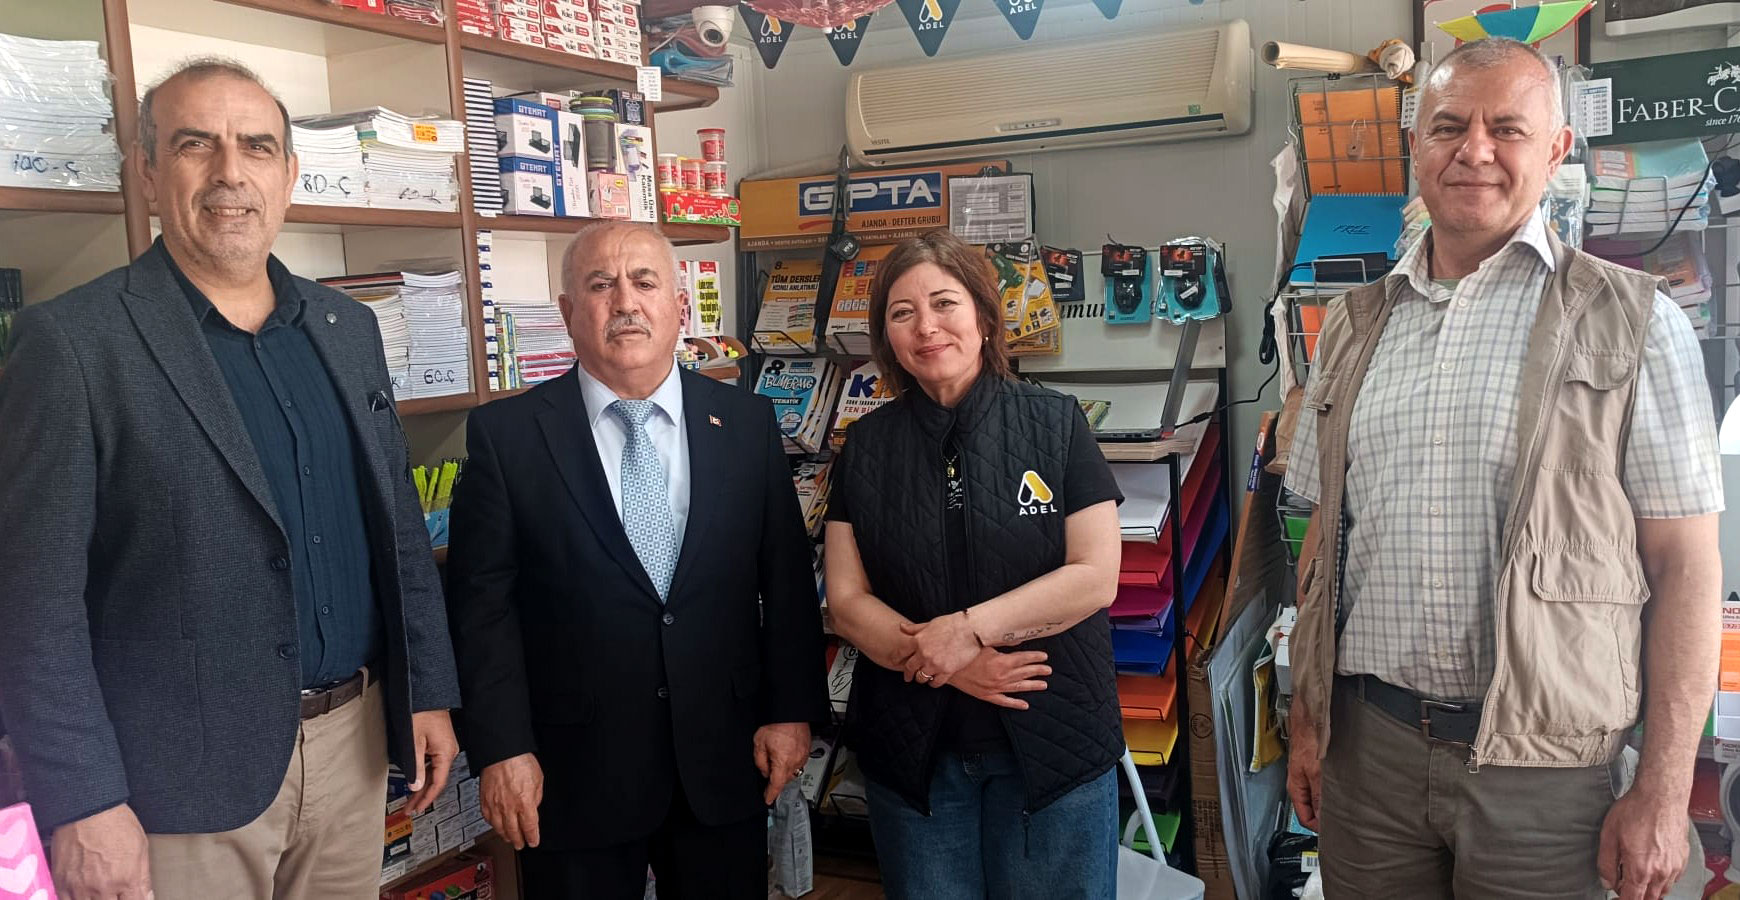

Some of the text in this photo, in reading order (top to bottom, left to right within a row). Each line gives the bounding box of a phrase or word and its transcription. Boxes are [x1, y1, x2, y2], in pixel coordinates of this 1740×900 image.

[1009, 3, 1037, 15] ADEL
[918, 21, 944, 31] ADEL
[833, 32, 858, 40] ADEL
[1616, 86, 1740, 124] FABER-C
[1705, 118, 1727, 127] since
[803, 178, 935, 211] GPTA
[862, 219, 887, 228] AJANDA
[893, 217, 916, 226] DEFTER
[918, 215, 940, 224] GRUBU
[771, 273, 788, 283] TÜM
[765, 360, 785, 376] 8
[764, 374, 814, 390] BUMERANG
[1018, 503, 1058, 516] ADEL
